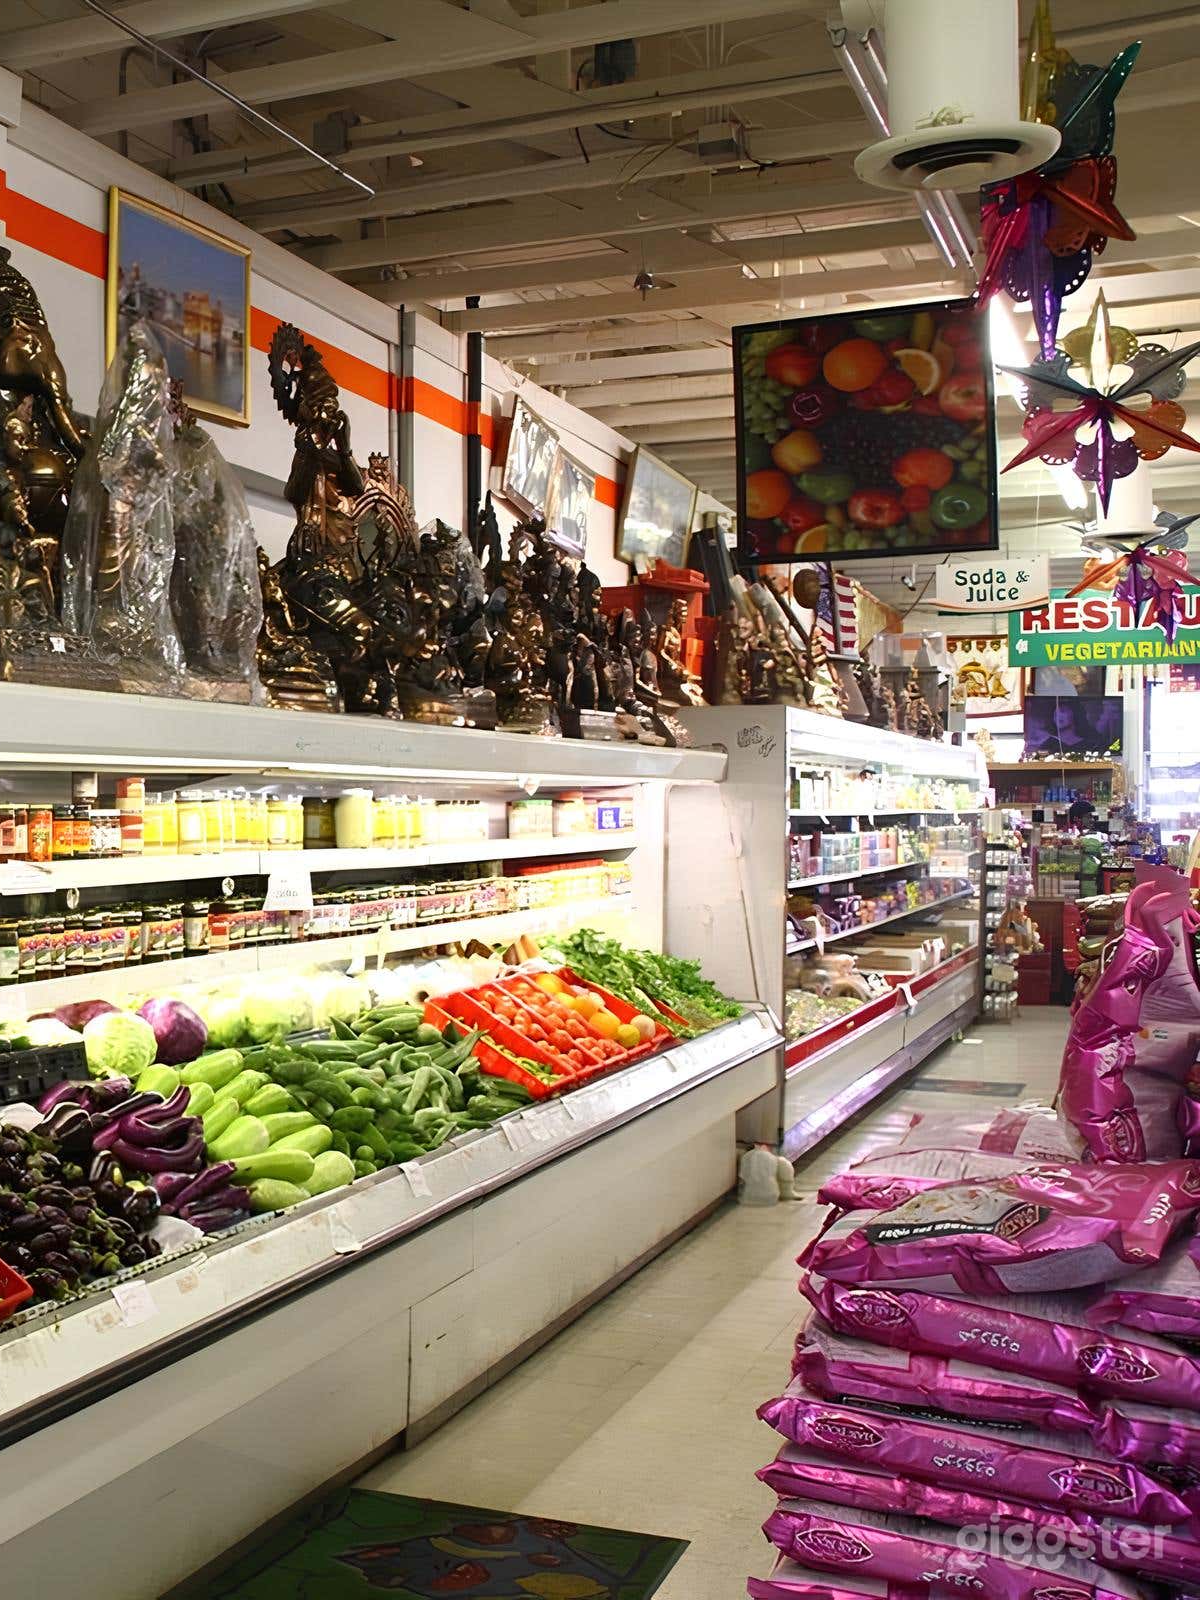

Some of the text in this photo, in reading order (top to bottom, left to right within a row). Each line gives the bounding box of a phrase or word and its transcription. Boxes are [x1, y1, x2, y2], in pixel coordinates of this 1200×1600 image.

[955, 568, 1030, 588] Soda &
[965, 584, 1020, 603] Juice
